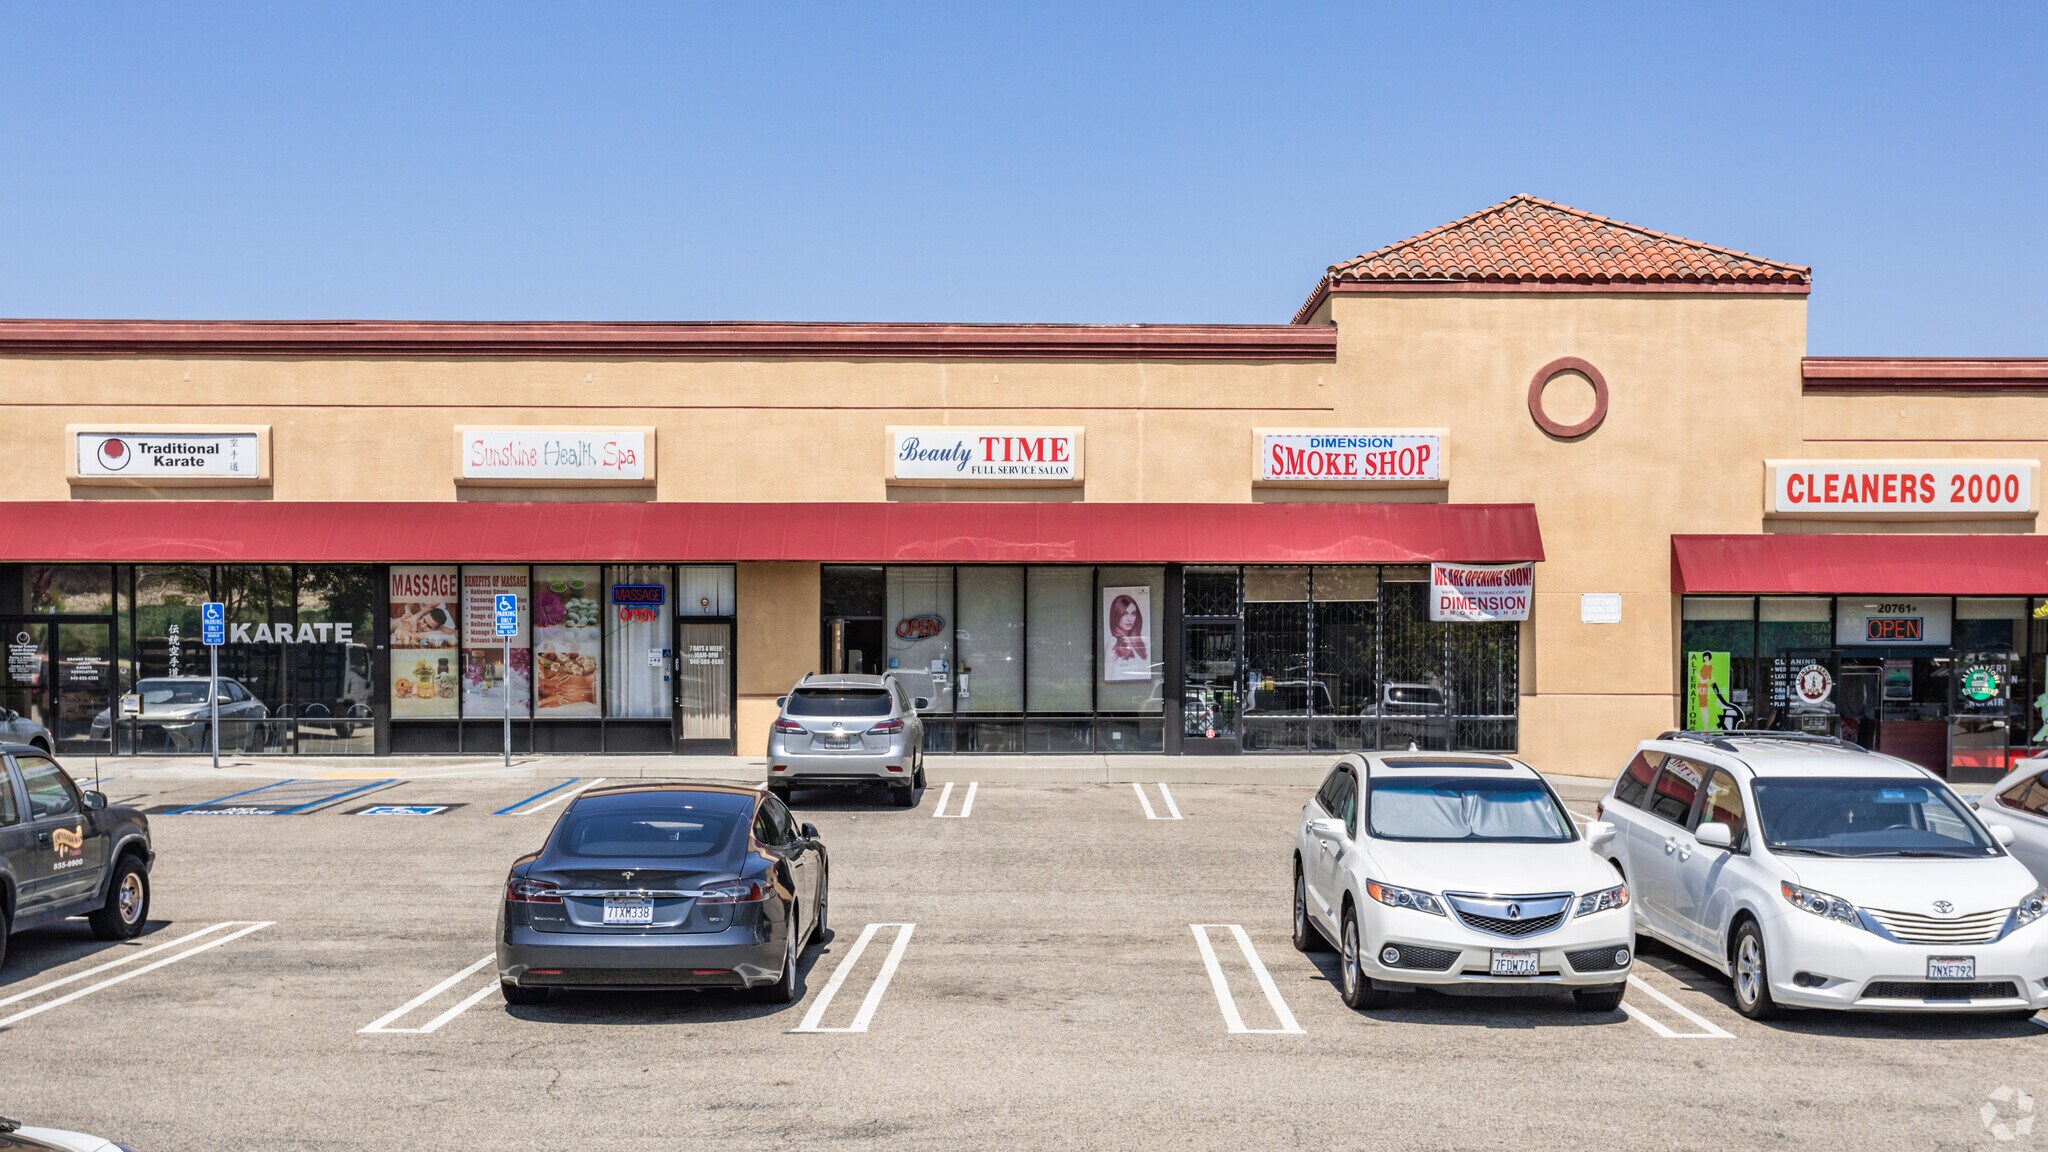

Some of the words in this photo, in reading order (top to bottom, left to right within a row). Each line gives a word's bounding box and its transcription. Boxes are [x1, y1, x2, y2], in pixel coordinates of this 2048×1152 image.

[138, 443, 219, 454] Traditional
[1310, 438, 1393, 448] DIMENSION
[154, 455, 205, 467] Karate
[472, 440, 537, 467] Sunshine
[544, 441, 597, 467] Health
[603, 441, 637, 471] Spa
[899, 437, 972, 472] Beauty
[979, 437, 1069, 463] TIME
[1271, 443, 1358, 476] SMOKE
[1364, 444, 1431, 476] SHOP
[971, 466, 996, 475] FULL
[998, 466, 1037, 475] SERVICE
[1038, 466, 1069, 475] SALON
[1786, 473, 1936, 504] CLEANERS
[1950, 474, 2020, 504] 2000
[464, 575, 491, 588] BENEFITS
[493, 575, 500, 587] OF
[501, 575, 528, 588] MASSAGE
[1434, 567, 1447, 586] WE
[1448, 568, 1466, 587] ARE
[1465, 569, 1503, 587] OPENING
[1503, 567, 1532, 587] SOON!
[392, 574, 457, 597] MASSAGE
[615, 589, 660, 601] MASSAGE
[1440, 596, 1526, 610] DIMENSION
[1877, 603, 1911, 614] 20761
[619, 608, 655, 622] OPEN
[230, 623, 353, 644] KARATE
[896, 618, 940, 637] OPEN
[1868, 620, 1920, 639] OPEN
[1774, 658, 1817, 666] CLANING
[53, 858, 84, 870] 855-9900
[608, 906, 650, 918] 7TXM338
[1494, 959, 1536, 971] 7FDW716
[1930, 965, 1972, 977] 7NXE792
